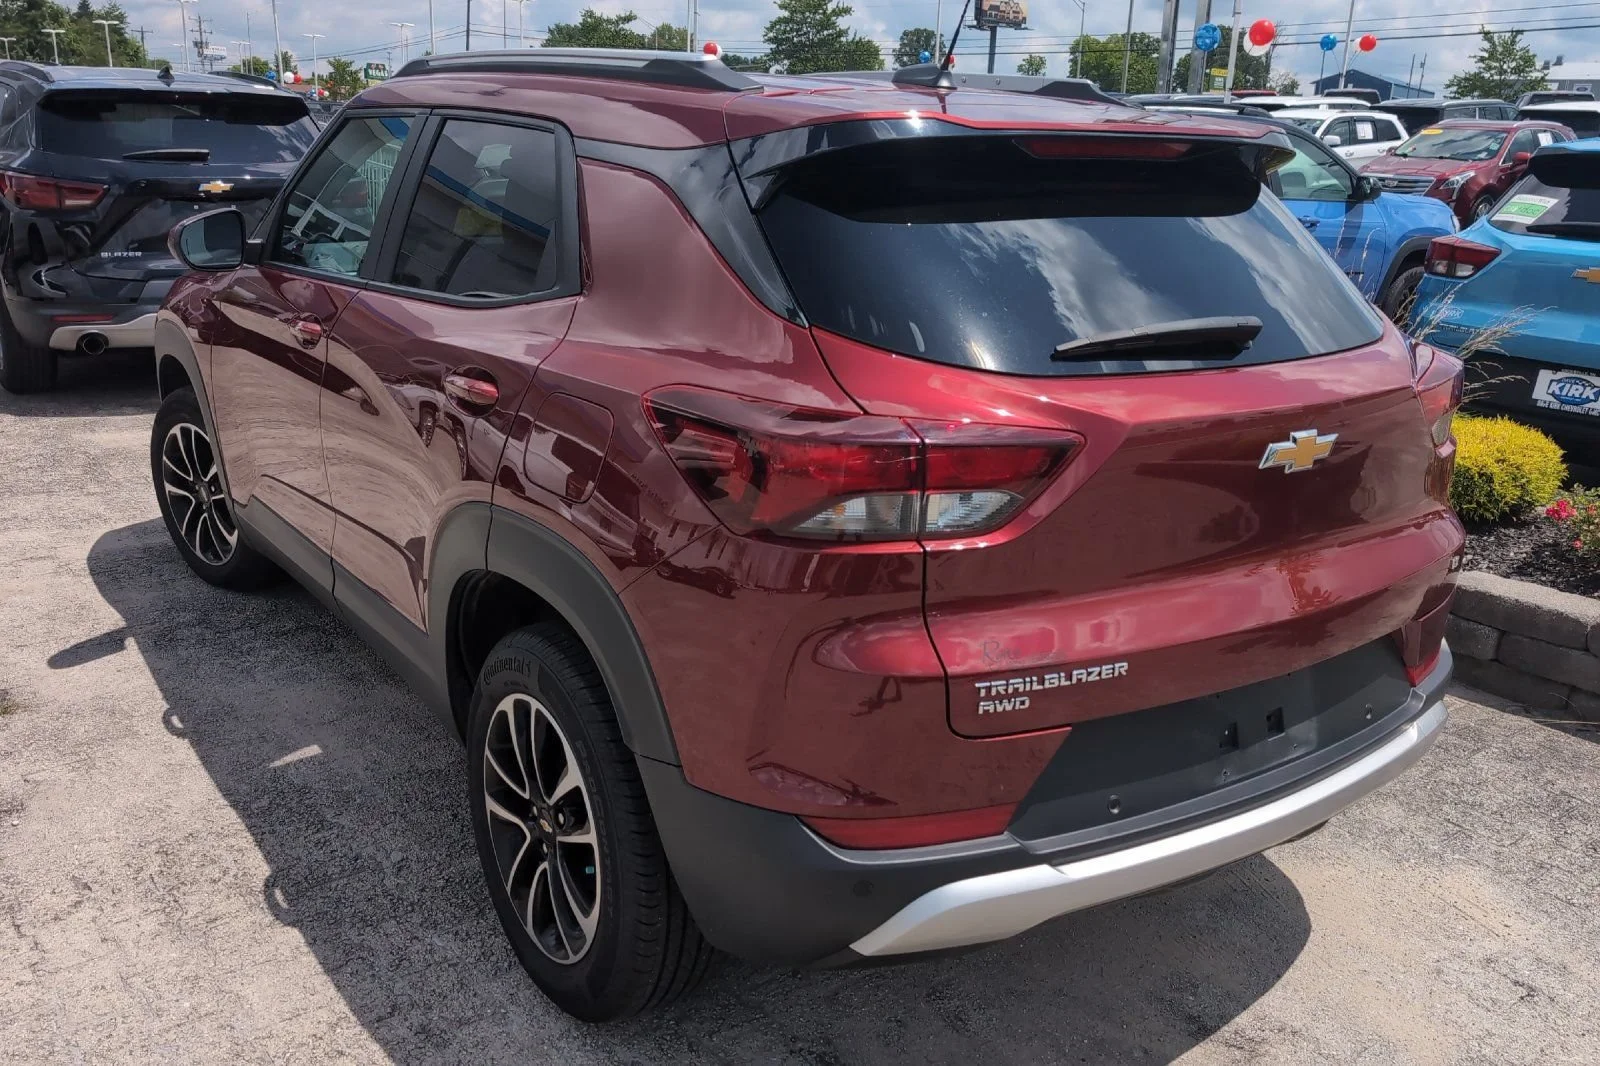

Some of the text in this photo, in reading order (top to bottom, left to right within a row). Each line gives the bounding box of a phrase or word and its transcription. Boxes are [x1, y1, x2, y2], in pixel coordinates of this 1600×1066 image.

[1547, 381, 1600, 401] KIRK
[483, 655, 525, 686] Continental
[974, 661, 1129, 697] TRAILBLAZER
[977, 696, 1031, 715] AWD
